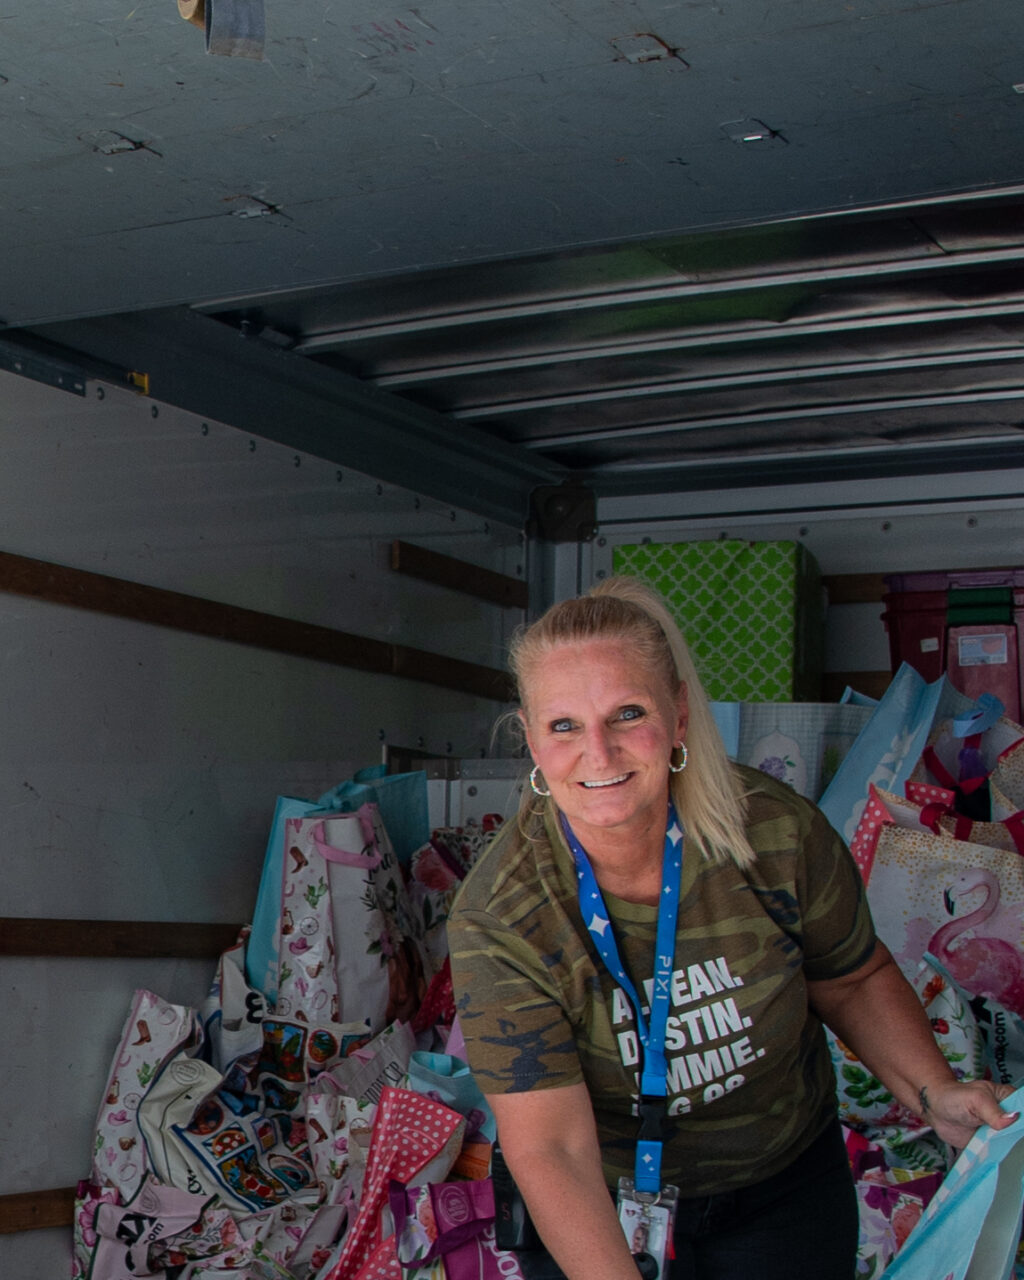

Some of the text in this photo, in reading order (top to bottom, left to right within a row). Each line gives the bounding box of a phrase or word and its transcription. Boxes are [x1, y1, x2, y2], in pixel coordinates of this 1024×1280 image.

[613, 957, 744, 1024] AEAN.
[656, 956, 672, 1000] PIXI
[617, 998, 753, 1066] DSTIN.
